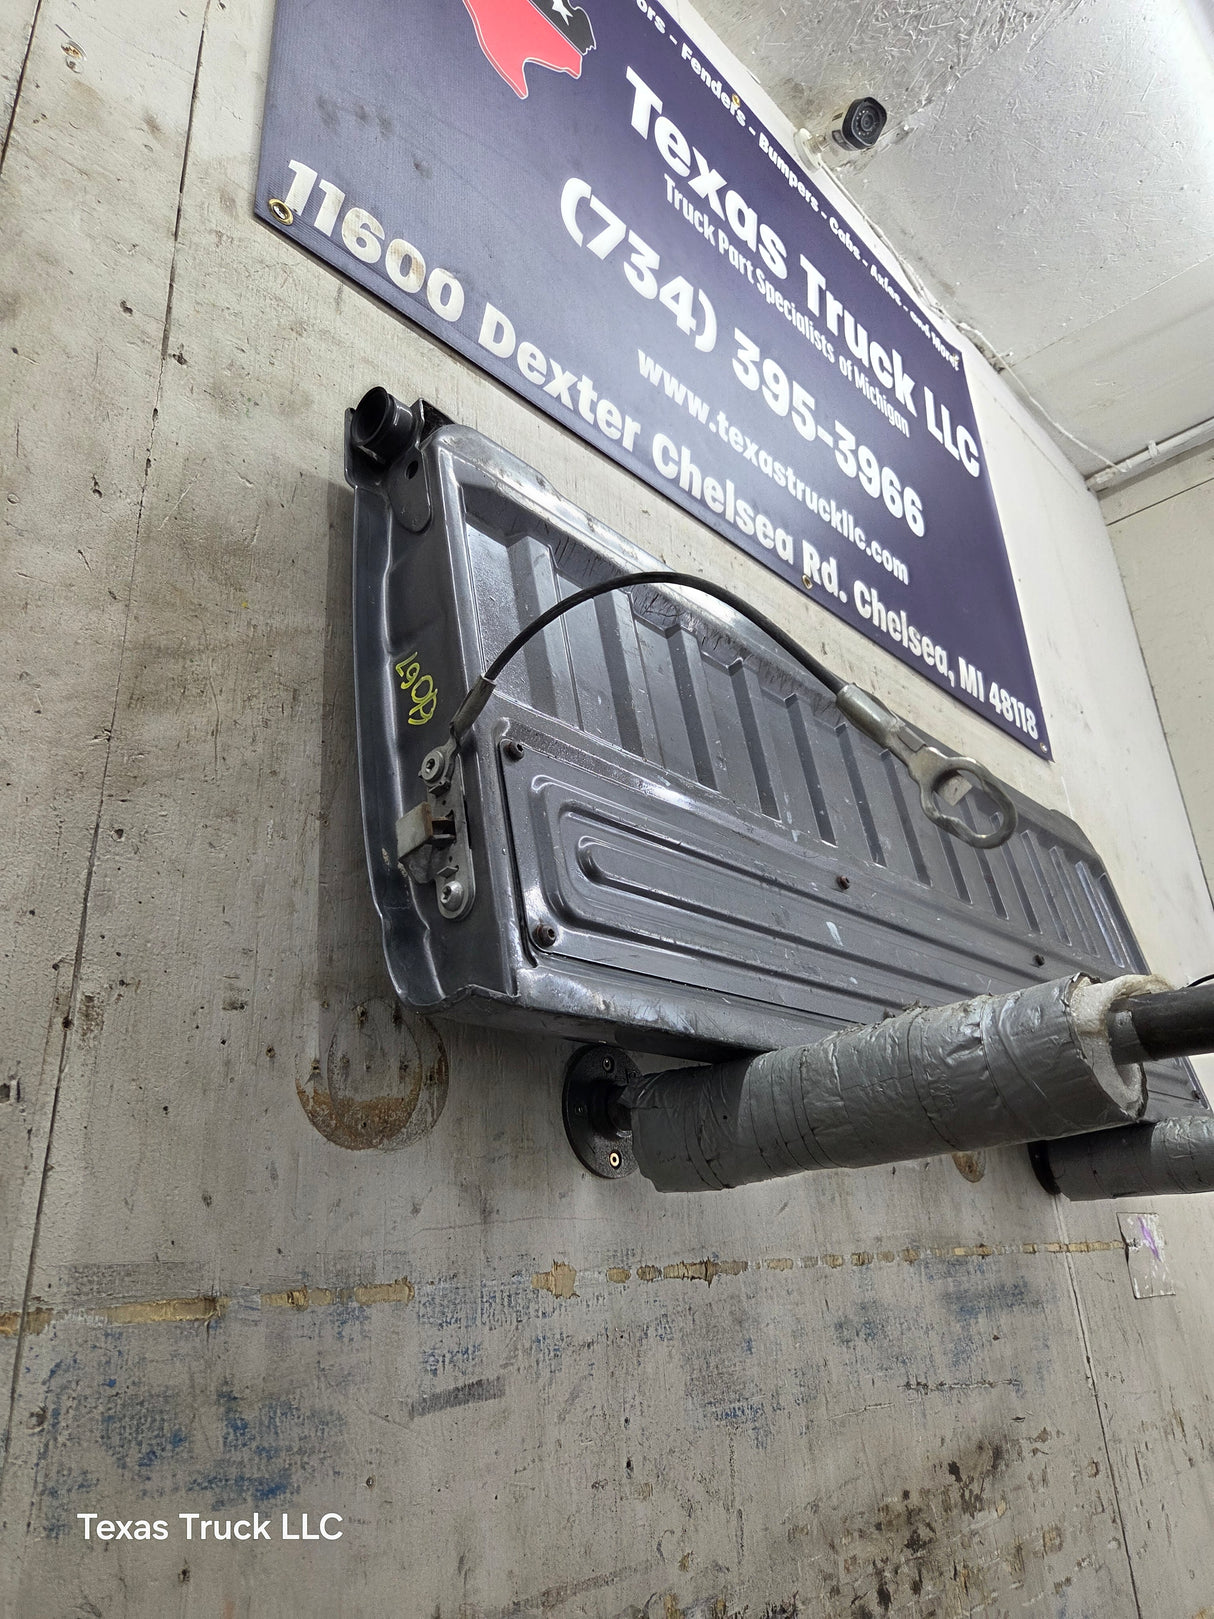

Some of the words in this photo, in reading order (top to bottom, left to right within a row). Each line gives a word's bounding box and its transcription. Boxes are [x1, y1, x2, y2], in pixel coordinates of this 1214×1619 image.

[626, 66, 788, 279] Texas
[799, 253, 918, 417] Truck
[923, 386, 980, 478] LLC
[664, 173, 716, 247] Truck
[718, 229, 754, 284] Part
[756, 268, 836, 363] Specialists
[855, 371, 910, 438] Michigan
[681, 42, 746, 127] Fenders
[759, 132, 819, 212] Bumpers
[829, 216, 861, 260] Cabs
[870, 264, 902, 306] Axles
[909, 310, 931, 339] and
[284, 160, 465, 322] 11600
[478, 302, 642, 452] Dexter
[652, 433, 794, 565] Chelsea
[802, 539, 847, 603] Rd.
[854, 580, 955, 687] Chelsea,
[958, 656, 984, 702] MI
[988, 681, 1039, 740] 48118
[561, 178, 717, 352] (734)
[732, 328, 926, 537] 395-3966
[637, 349, 909, 585] www.texastruckllc.com
